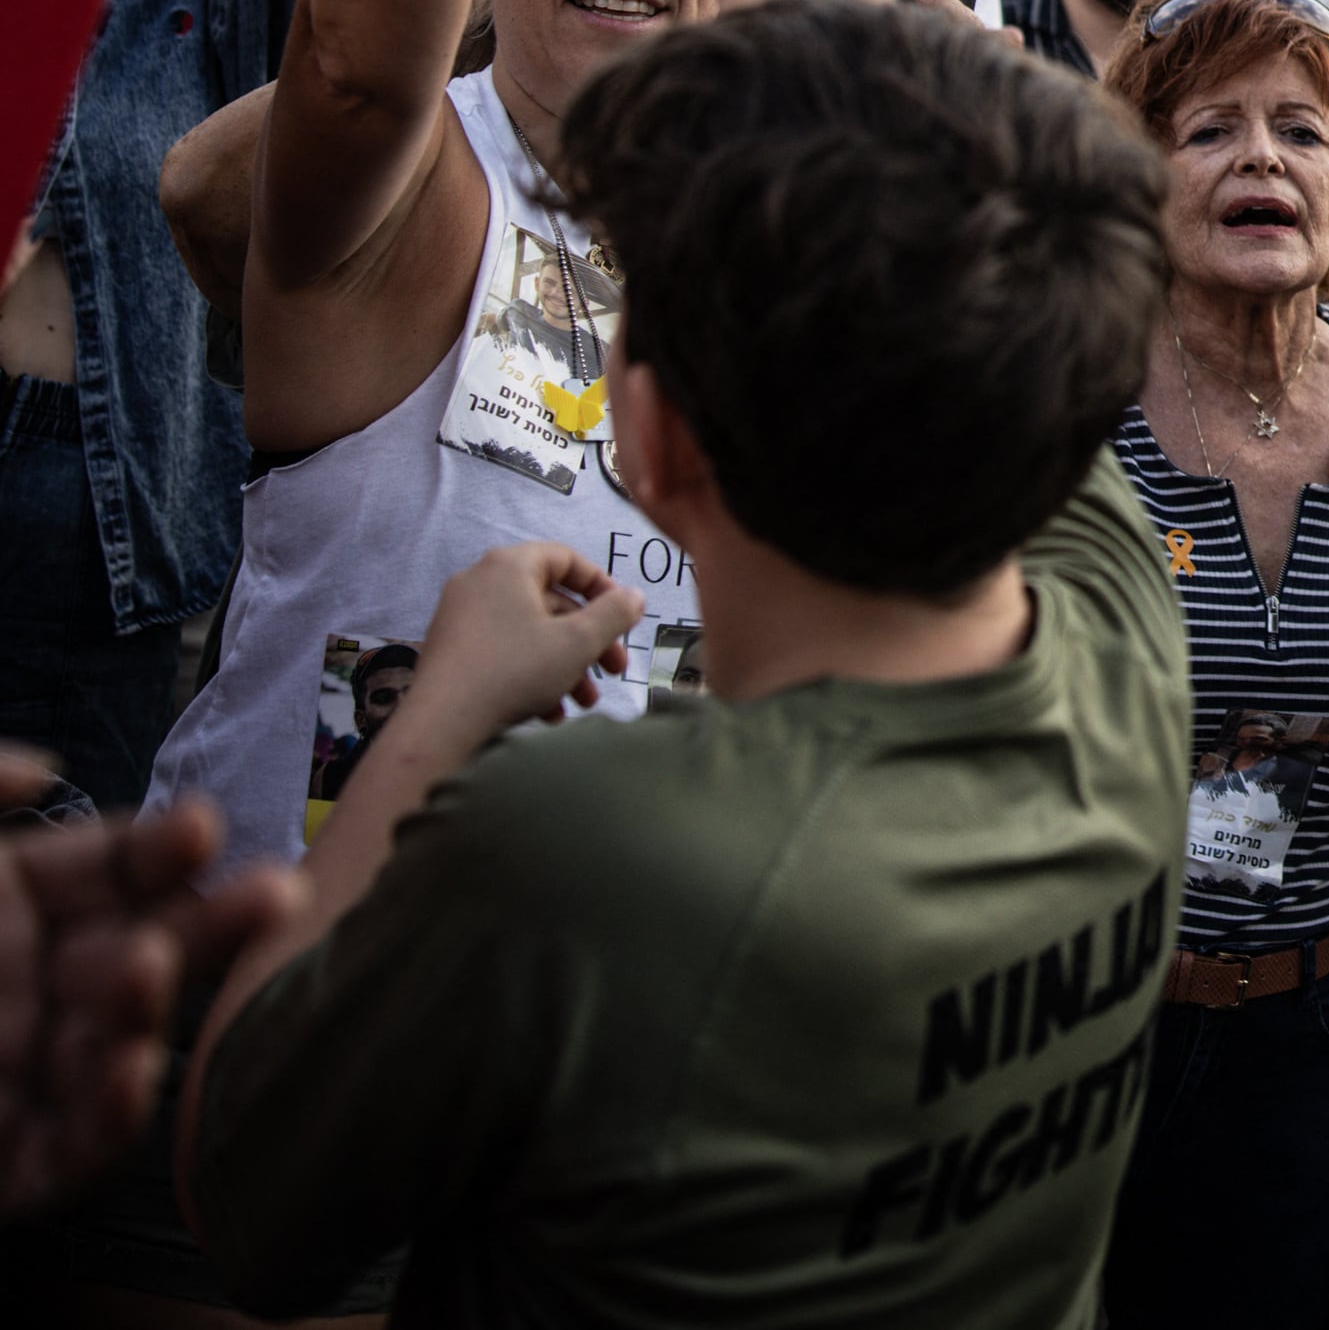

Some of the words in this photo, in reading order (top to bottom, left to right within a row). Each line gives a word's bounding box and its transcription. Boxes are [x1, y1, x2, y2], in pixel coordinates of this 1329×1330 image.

[468, 392, 520, 425] לשובך
[499, 384, 555, 423] מרימים
[523, 421, 569, 450] כוסית
[1190, 842, 1235, 861] לשובך
[1213, 830, 1262, 849] מרימים
[1236, 853, 1270, 869] כוסית
